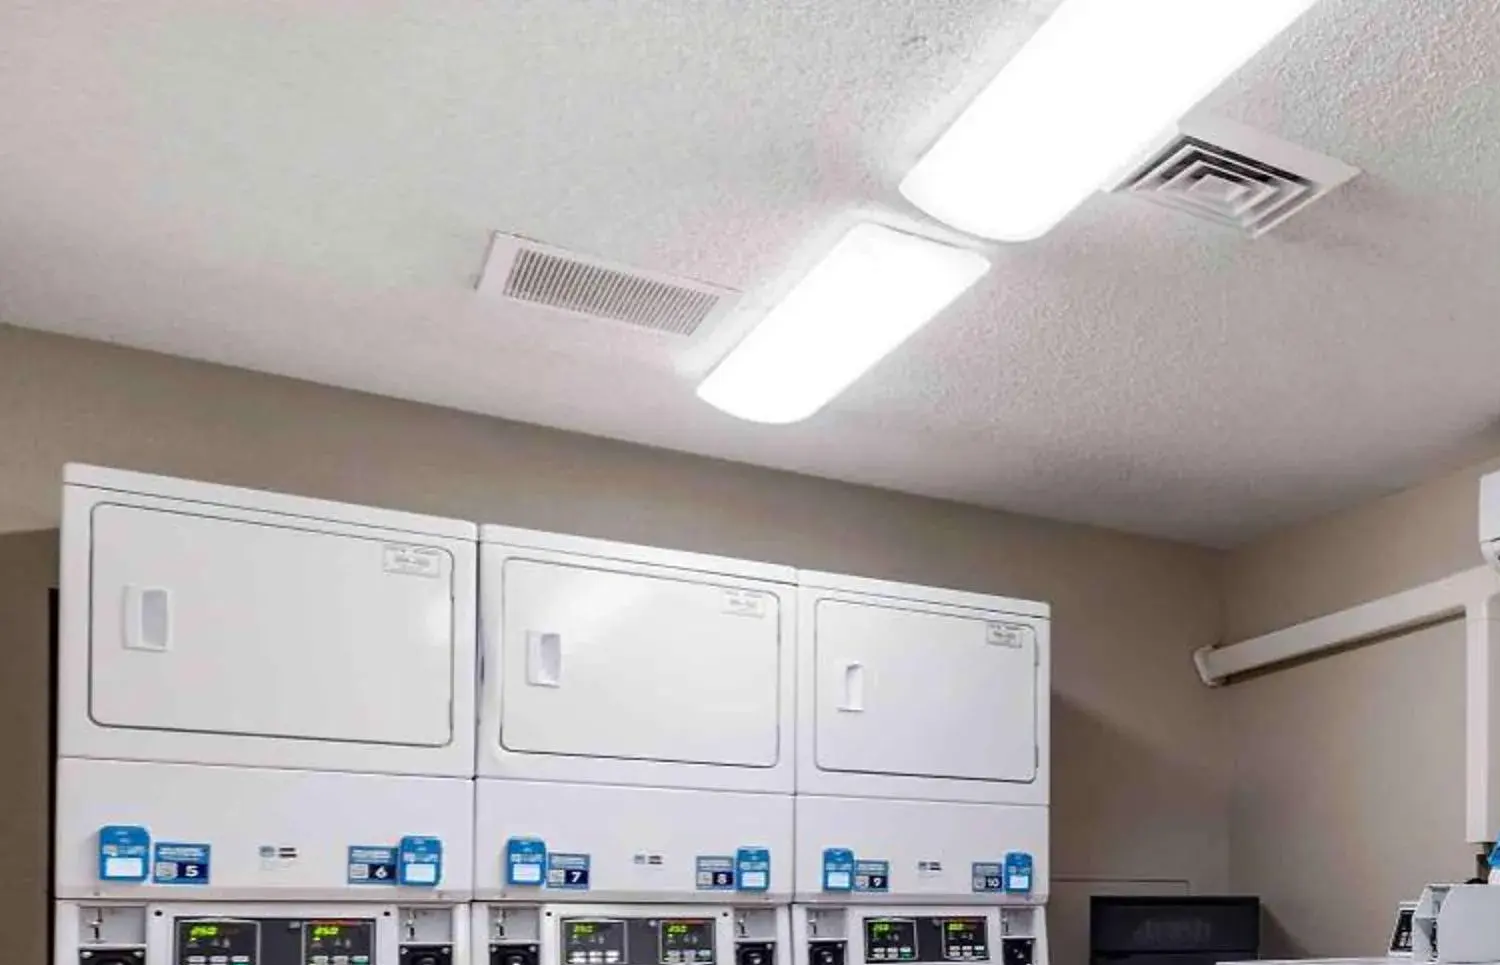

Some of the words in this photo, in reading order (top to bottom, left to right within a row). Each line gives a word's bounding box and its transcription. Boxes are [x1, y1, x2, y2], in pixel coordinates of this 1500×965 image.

[184, 865, 199, 877] 5
[375, 866, 388, 879] 6
[571, 871, 582, 882] 7
[717, 873, 727, 884] 8
[873, 877, 882, 887] 9
